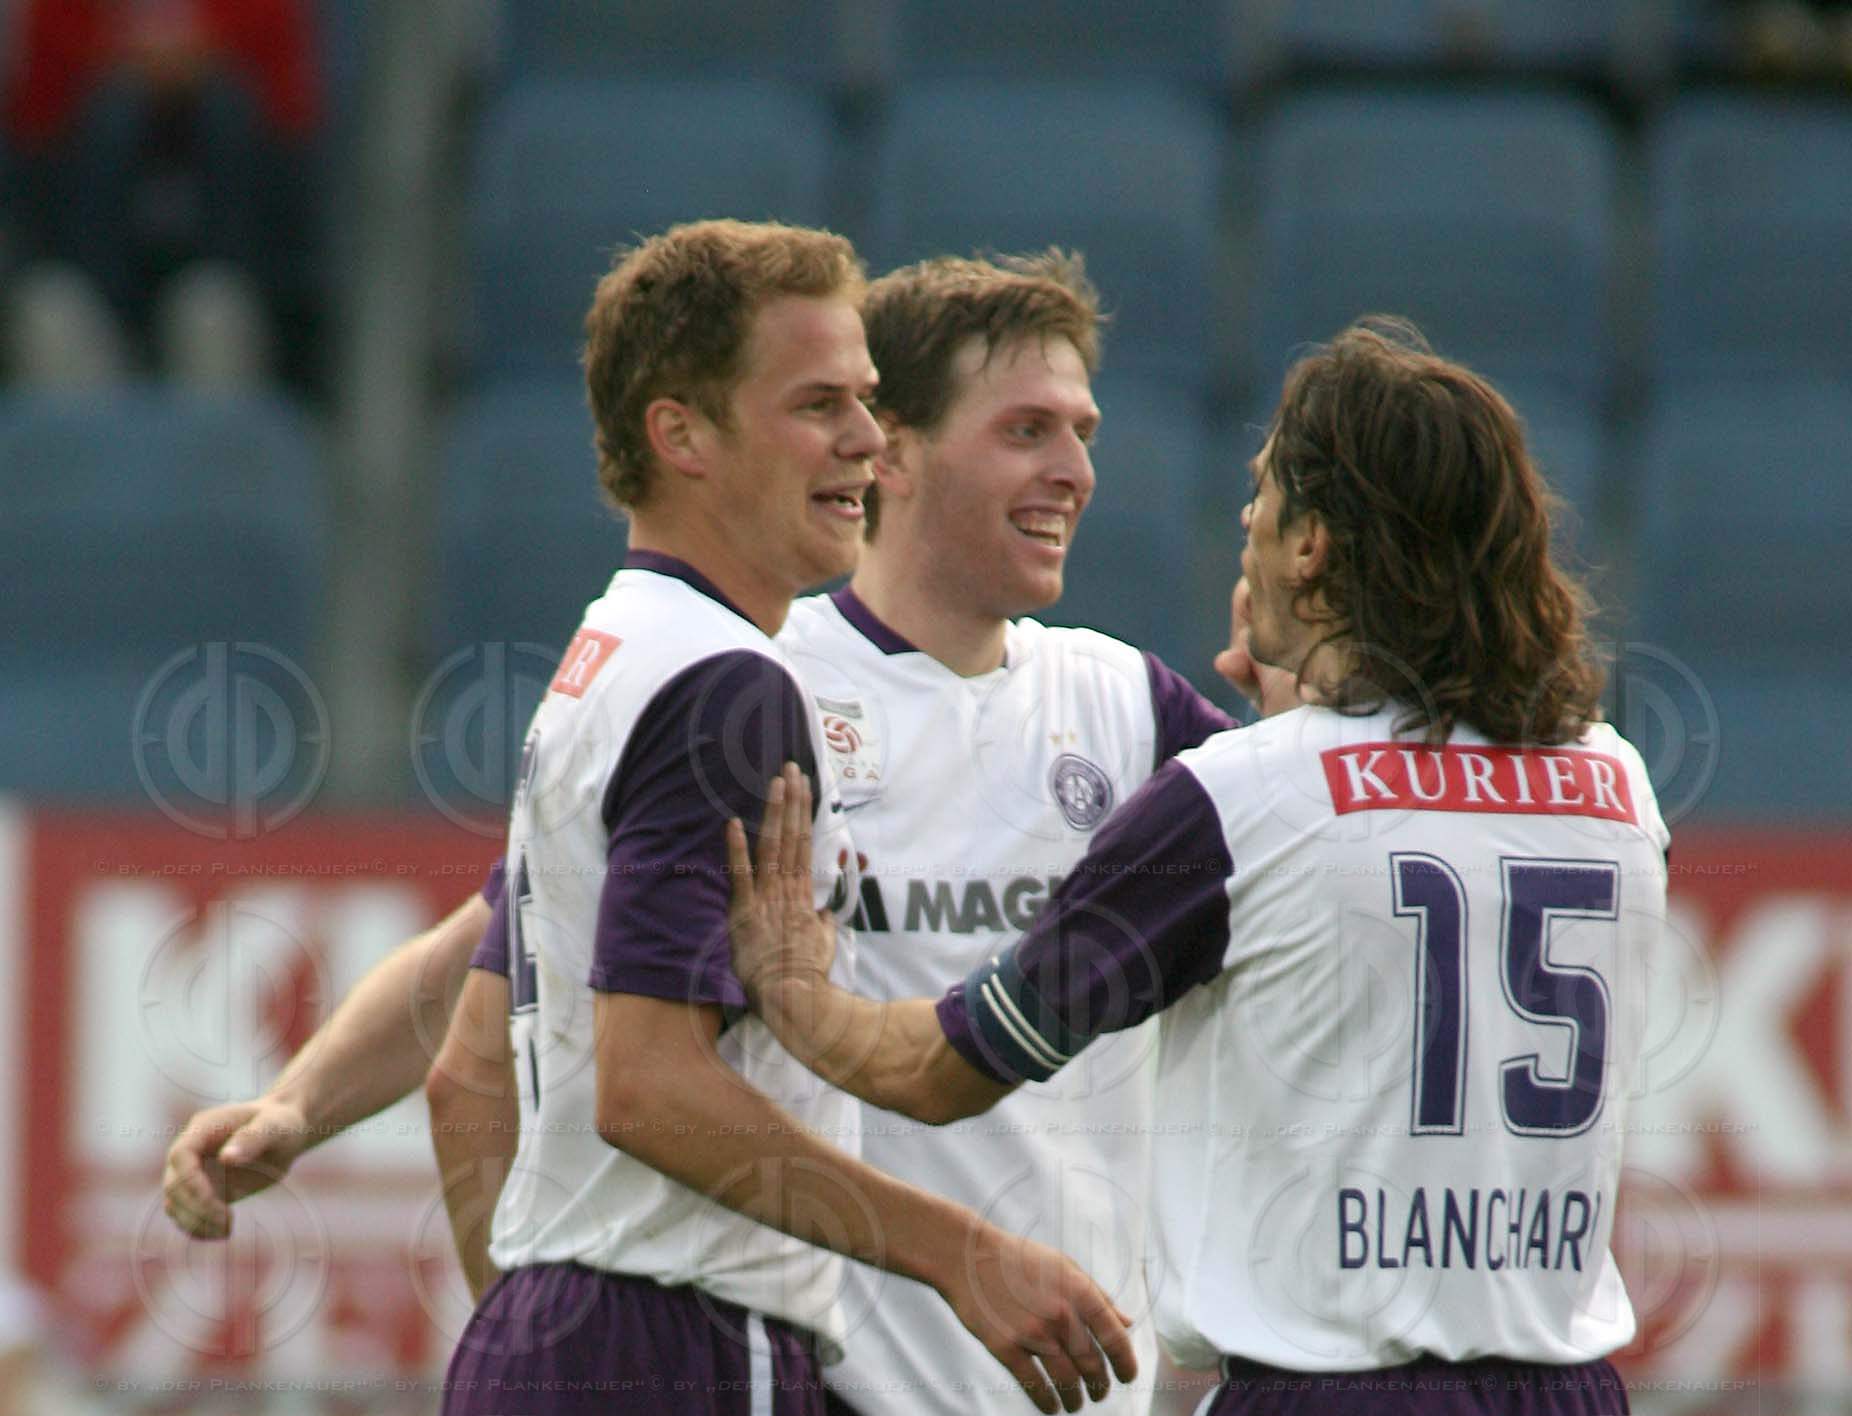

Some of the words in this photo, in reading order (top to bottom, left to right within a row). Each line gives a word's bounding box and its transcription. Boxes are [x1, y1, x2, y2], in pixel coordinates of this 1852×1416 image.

[1338, 750, 1626, 813] KURIER
[904, 876, 1068, 933] MAG
[1389, 851, 1620, 1139] 15
[1338, 1187, 1602, 1272] BLANCHAR
